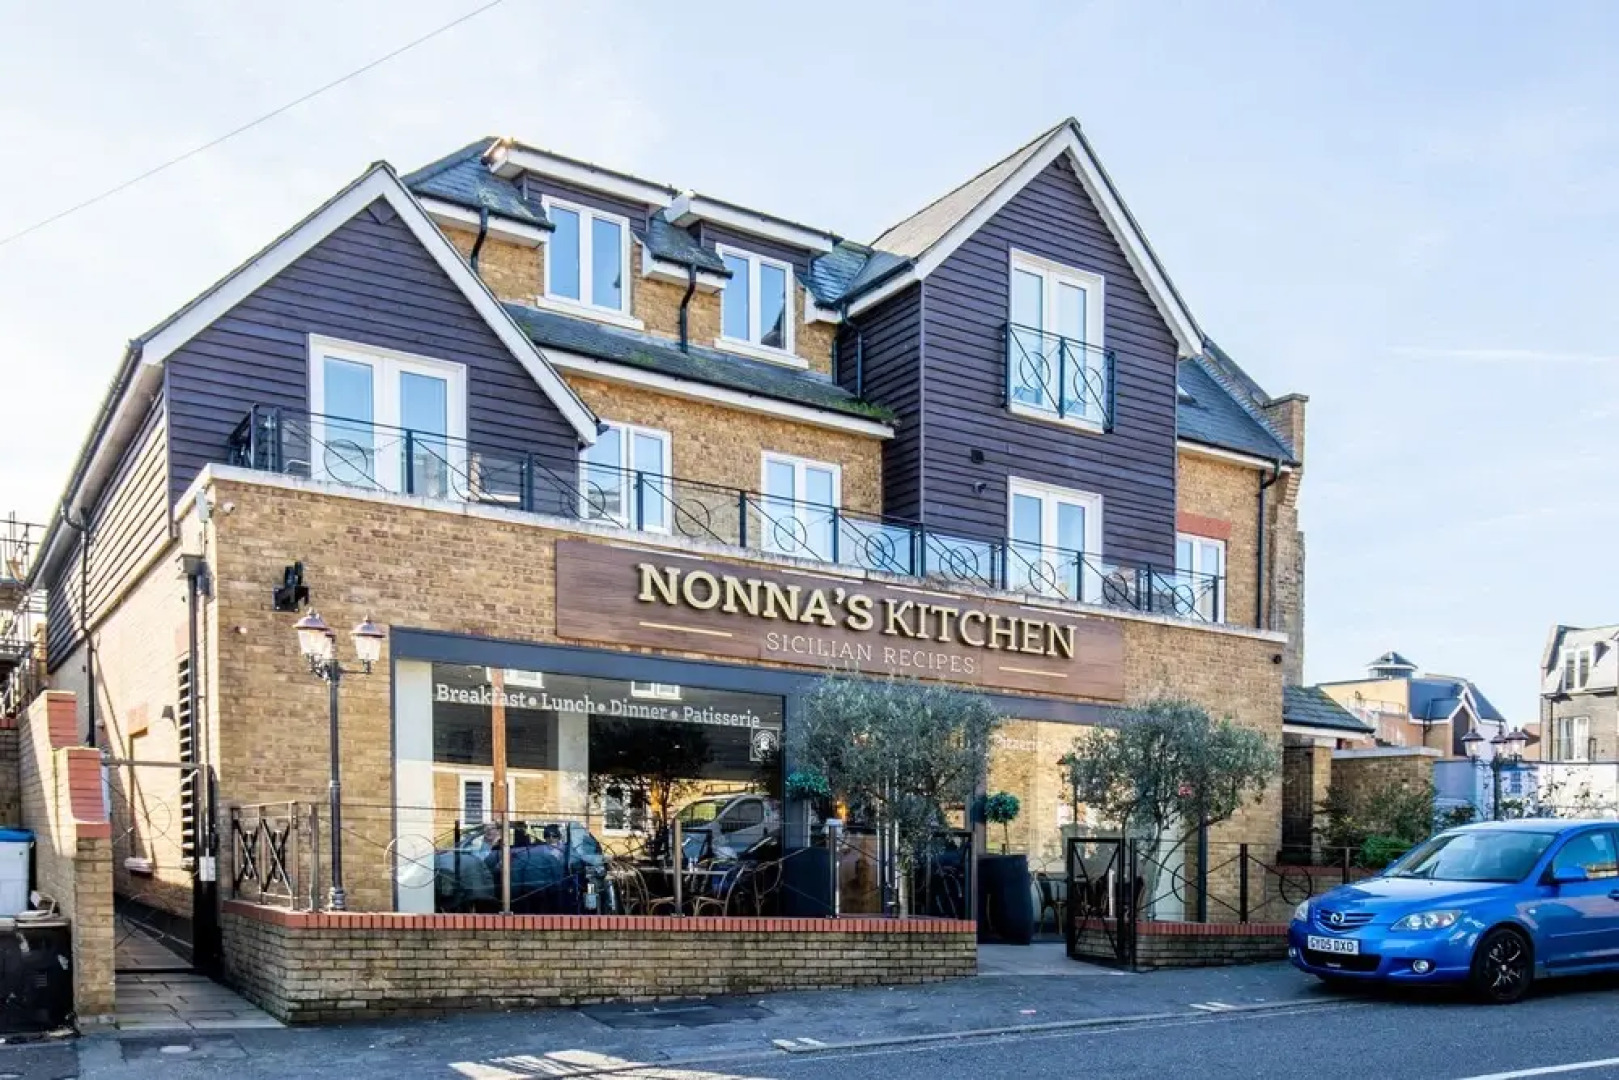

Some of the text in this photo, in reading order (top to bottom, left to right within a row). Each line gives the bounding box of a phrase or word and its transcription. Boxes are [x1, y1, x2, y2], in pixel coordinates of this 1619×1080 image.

[638, 562, 1077, 658] NONNA'S KITCHEN
[766, 632, 975, 674] SICILIAN RECIPES
[435, 683, 761, 728] Breakfast Lunch Dinner Patisserie
